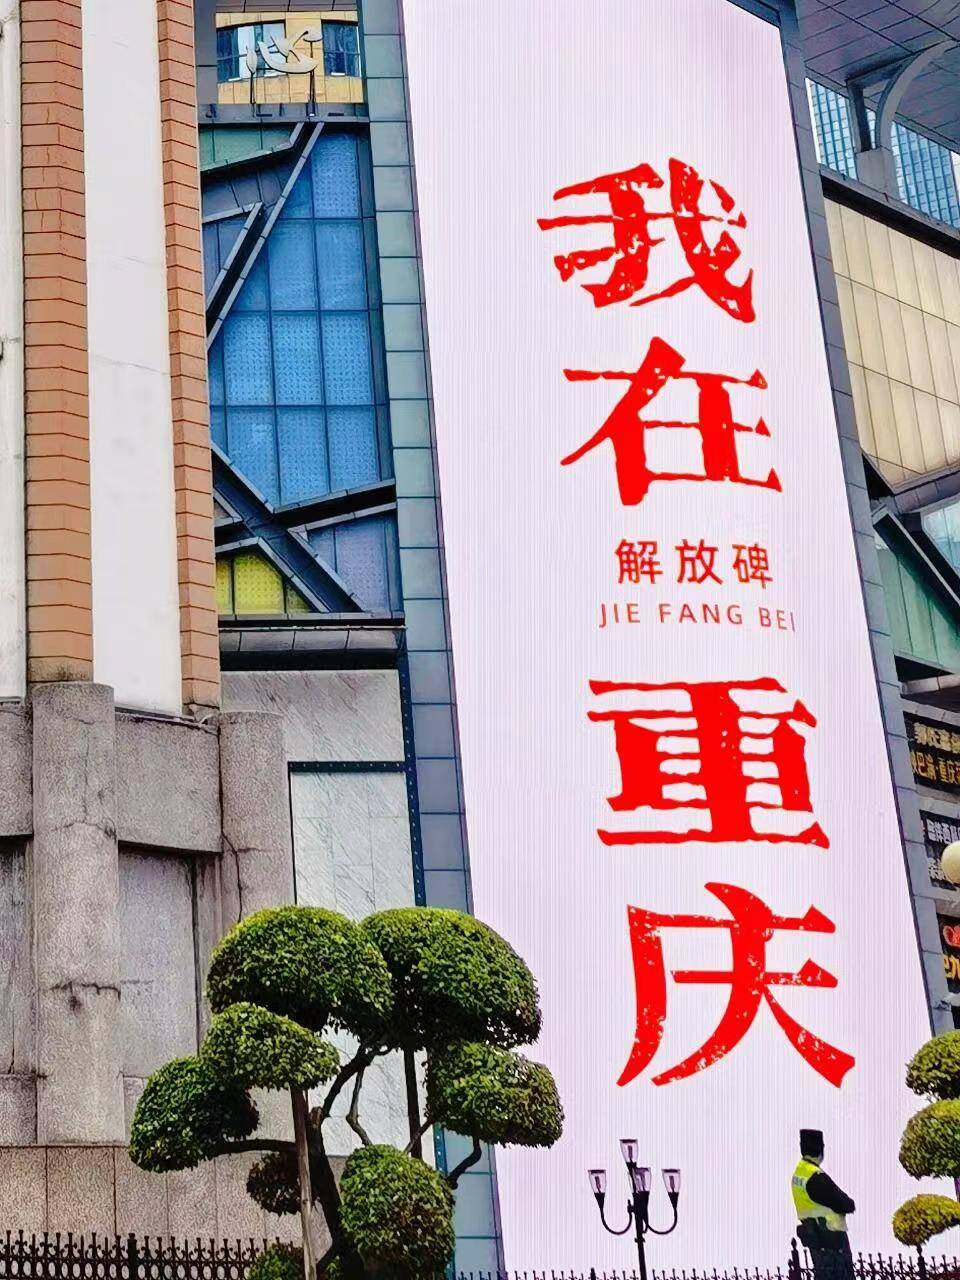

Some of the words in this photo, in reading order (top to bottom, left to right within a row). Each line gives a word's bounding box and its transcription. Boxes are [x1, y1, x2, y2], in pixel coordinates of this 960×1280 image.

[614, 538, 774, 589] 解放碑
[598, 603, 641, 629] JIE
[658, 603, 743, 625] FANG
[757, 606, 796, 633] BEI
